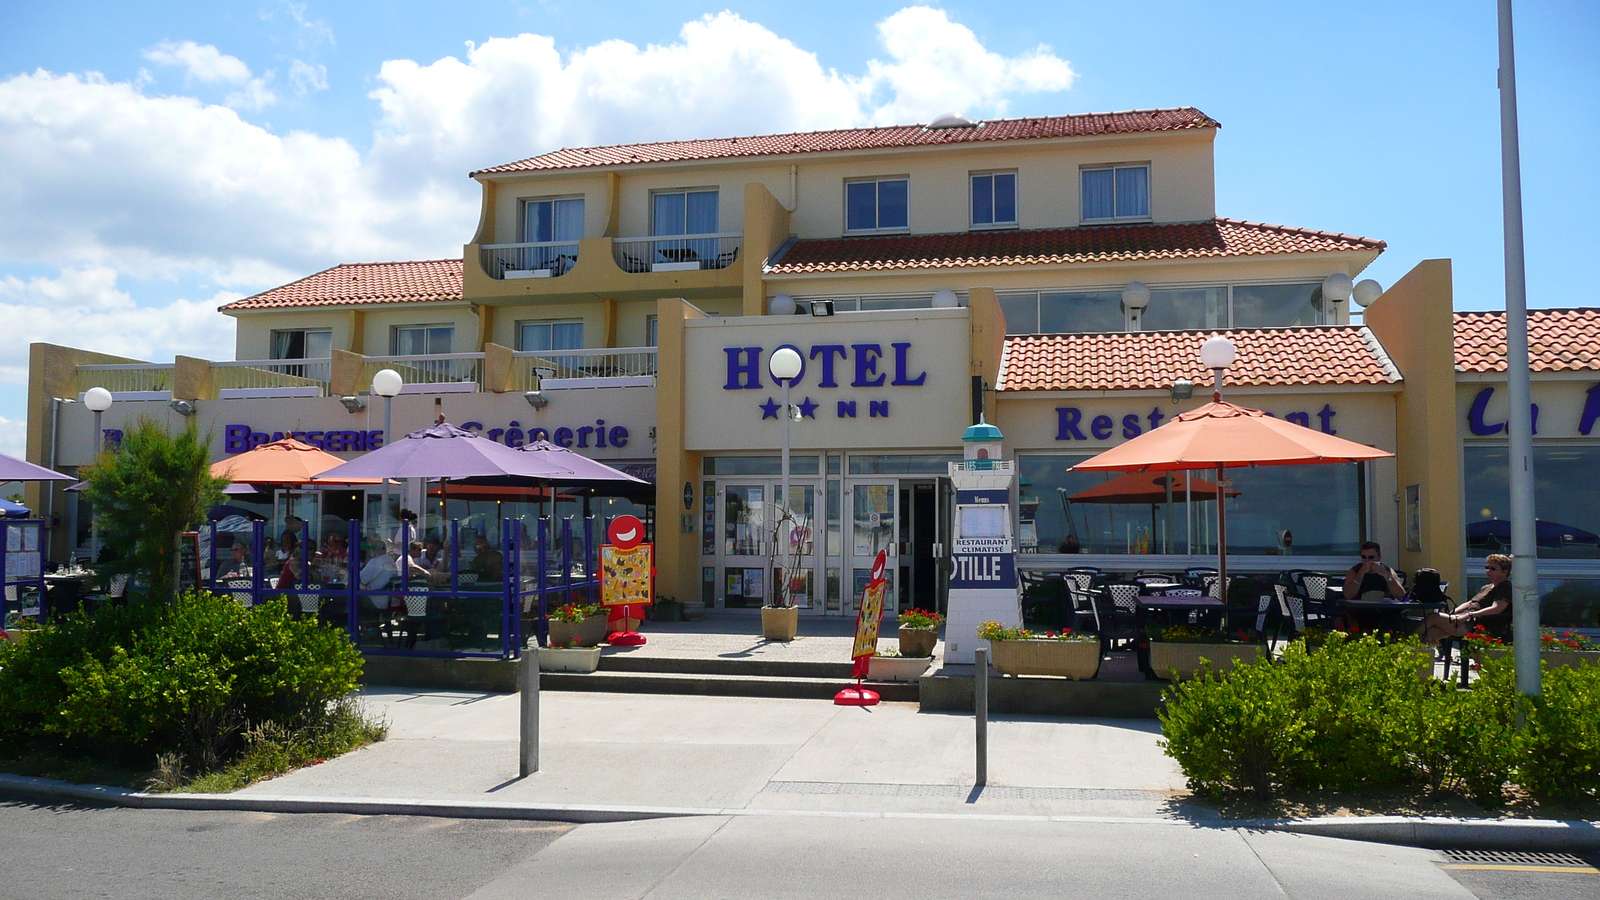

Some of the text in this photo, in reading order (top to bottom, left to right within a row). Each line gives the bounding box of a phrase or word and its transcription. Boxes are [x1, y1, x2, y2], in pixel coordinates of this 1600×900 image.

[723, 342, 926, 389] HOTEL
[1055, 404, 1337, 440] Restnt
[1467, 387, 1538, 436] L
